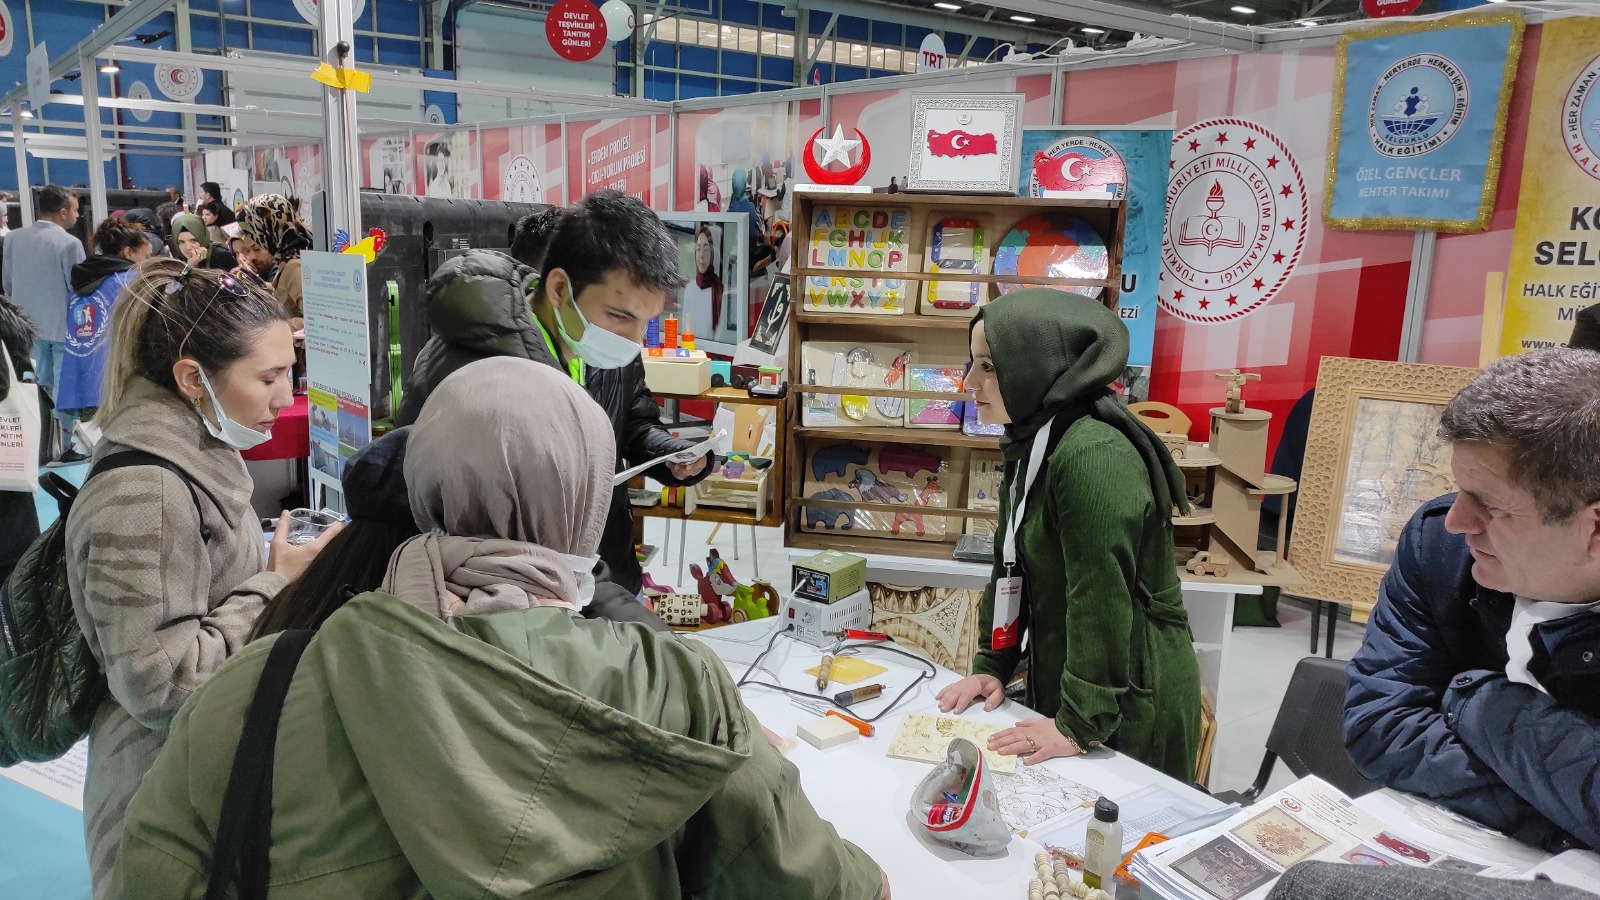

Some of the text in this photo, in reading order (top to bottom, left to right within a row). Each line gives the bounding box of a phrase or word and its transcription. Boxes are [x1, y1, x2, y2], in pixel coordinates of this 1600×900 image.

[557, 20, 595, 30] TEŞVİKLERİ
[563, 12, 590, 20] DEVLET
[561, 38, 592, 48] GÜNLERİ
[562, 30, 591, 39] TANITIM
[922, 51, 944, 69] TRT
[1383, 58, 1422, 81] HERYERDE
[1428, 58, 1456, 77] HERKES
[1451, 74, 1464, 92] İÇİN
[1450, 97, 1466, 126] EĞİTİM
[1568, 71, 1597, 132] HER ZAMAN
[609, 131, 631, 157] PROJESİ
[1047, 145, 1061, 157] HER
[1061, 140, 1084, 148] YERDE
[1374, 135, 1442, 155] HALK EĞİTİMİ
[623, 146, 646, 172] PROJESİ
[1215, 156, 1250, 176] MİLLİ
[1356, 166, 1461, 184] ÖZEL GENÇLER
[1248, 172, 1272, 219] EĞİTİM
[1570, 206, 1600, 231] K
[1219, 224, 1271, 284] BAKANLIĞI
[1533, 240, 1600, 266] SEL
[1523, 283, 1566, 298] HALK
